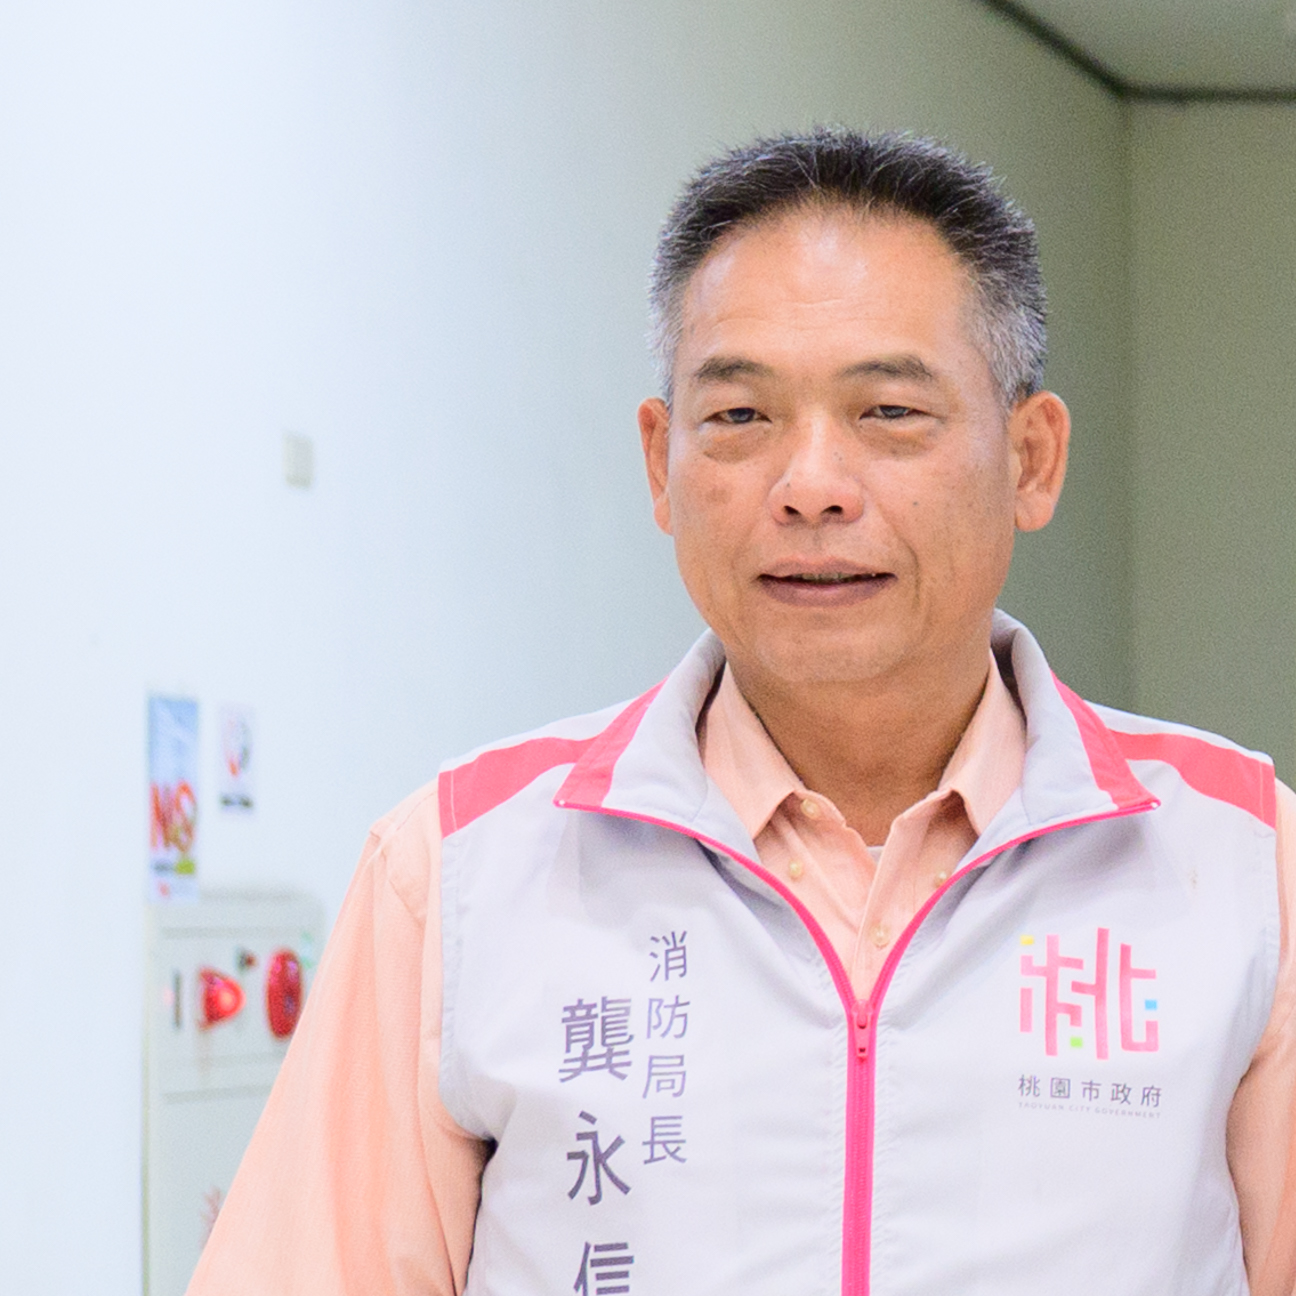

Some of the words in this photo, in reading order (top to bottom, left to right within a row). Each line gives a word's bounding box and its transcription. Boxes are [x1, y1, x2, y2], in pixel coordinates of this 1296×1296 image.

[641, 930, 690, 1166] 消防局長
[1018, 1074, 1162, 1108] 桃園市政府
